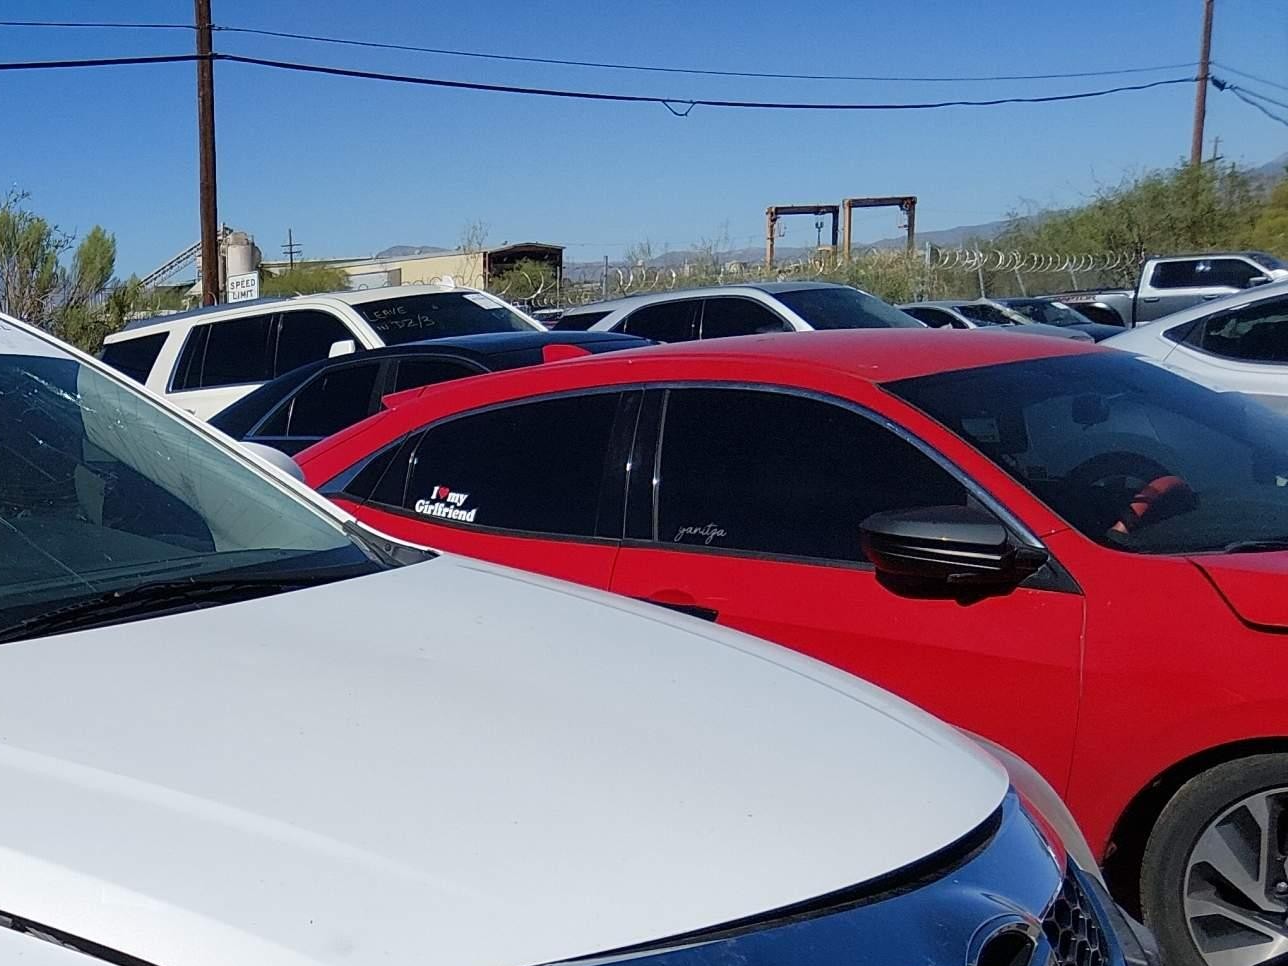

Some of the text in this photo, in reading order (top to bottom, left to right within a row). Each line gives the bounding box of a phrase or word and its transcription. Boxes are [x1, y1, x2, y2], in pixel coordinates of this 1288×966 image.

[230, 279, 256, 290] SPEED
[232, 289, 254, 300] LIMIT
[430, 486, 470, 507] I my
[414, 499, 478, 522] Girlfriend
